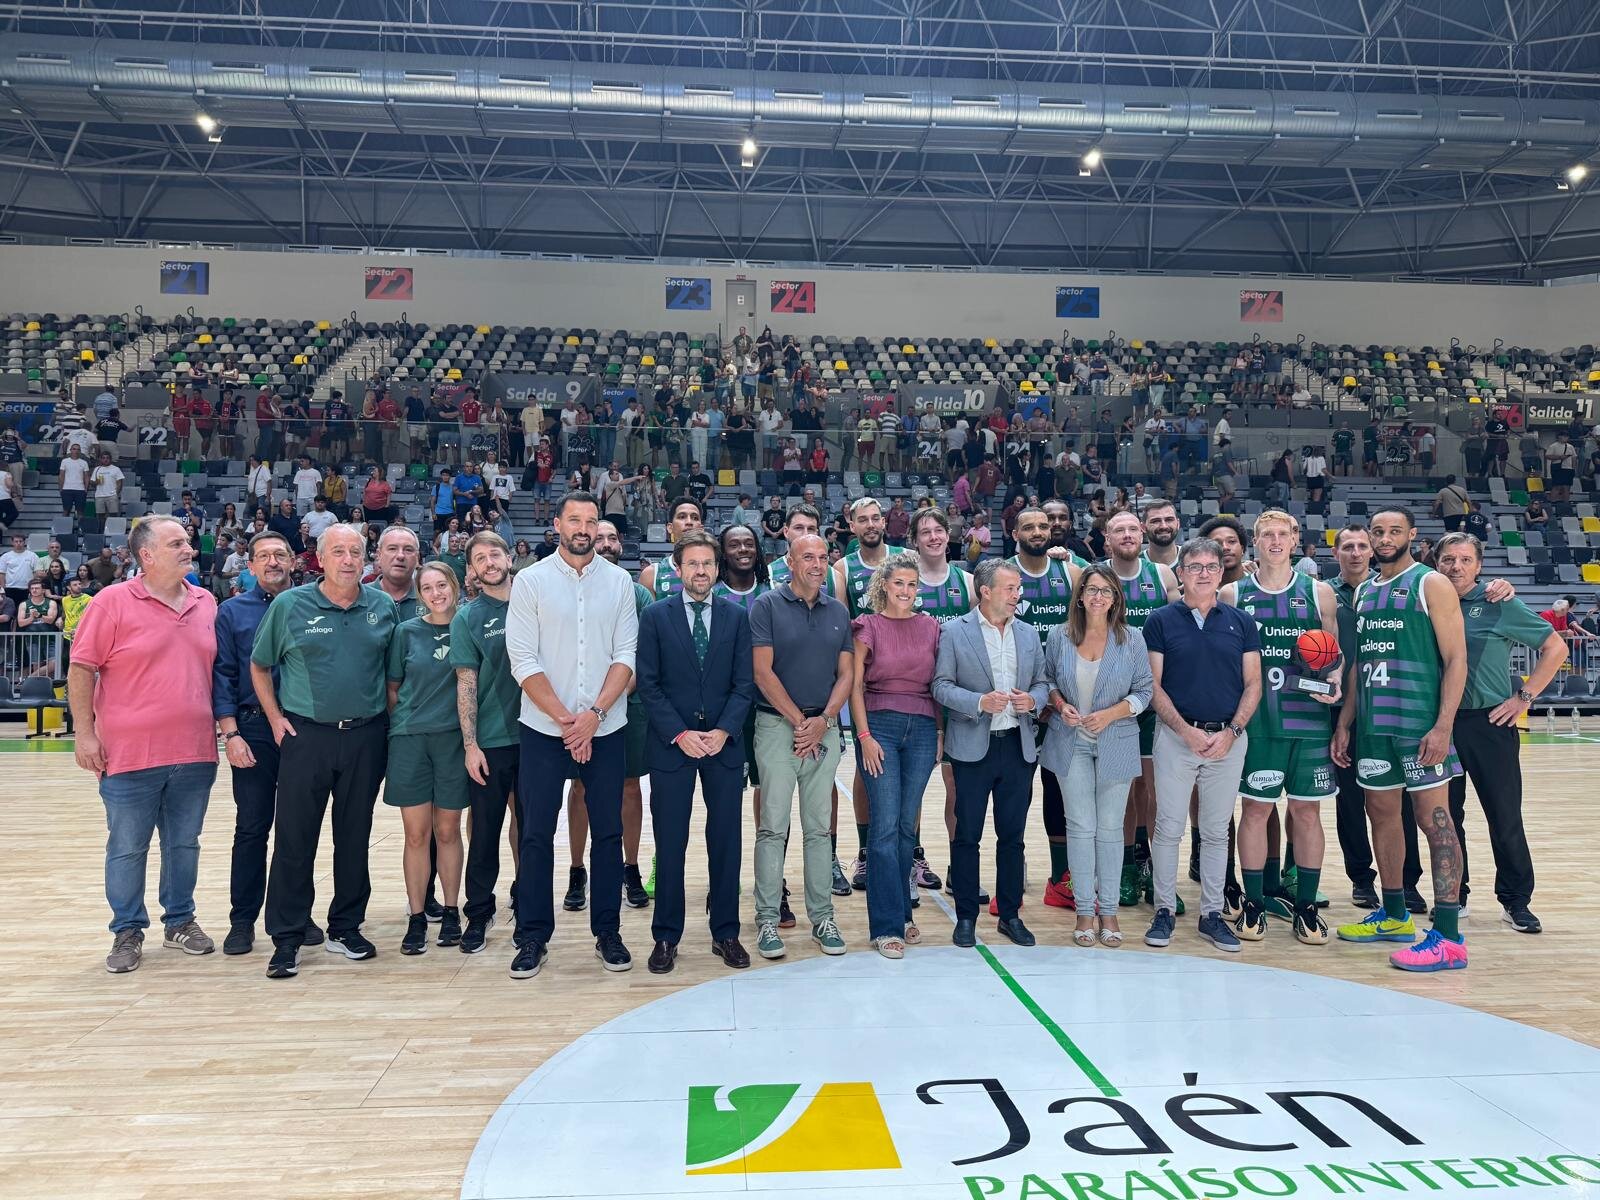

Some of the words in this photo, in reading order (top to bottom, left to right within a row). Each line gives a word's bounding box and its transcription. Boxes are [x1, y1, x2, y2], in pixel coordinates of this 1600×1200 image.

[160, 261, 192, 271] Sector
[364, 267, 396, 276] Sector
[366, 268, 413, 300] 22
[665, 277, 695, 287] Sector
[771, 281, 800, 290] Sector
[666, 279, 711, 310] 23
[771, 283, 815, 313] 24
[1056, 287, 1084, 295] Sector
[1240, 290, 1268, 299] Sector
[1242, 291, 1283, 322] 26
[506, 387, 558, 401] Salida
[566, 381, 581, 401] 9
[602, 388, 625, 396] Sector
[0, 402, 39, 413] Sector
[963, 389, 985, 410] 10
[1017, 395, 1038, 404] Sector
[1529, 405, 1573, 418] Salida
[1576, 398, 1593, 418] 11
[140, 426, 168, 446] 22
[1382, 426, 1417, 436] Secr
[918, 441, 942, 459] 24
[1032, 603, 1067, 614] Unicaja
[1366, 617, 1404, 632] Unicaja
[1267, 667, 1285, 690] 9
[1362, 661, 1390, 688] 24
[1314, 779, 1331, 790] lag
[915, 1072, 1425, 1166] Jaén
[963, 1159, 1299, 1200] PARAÍSO
[1304, 1154, 1600, 1194] INTERIO
